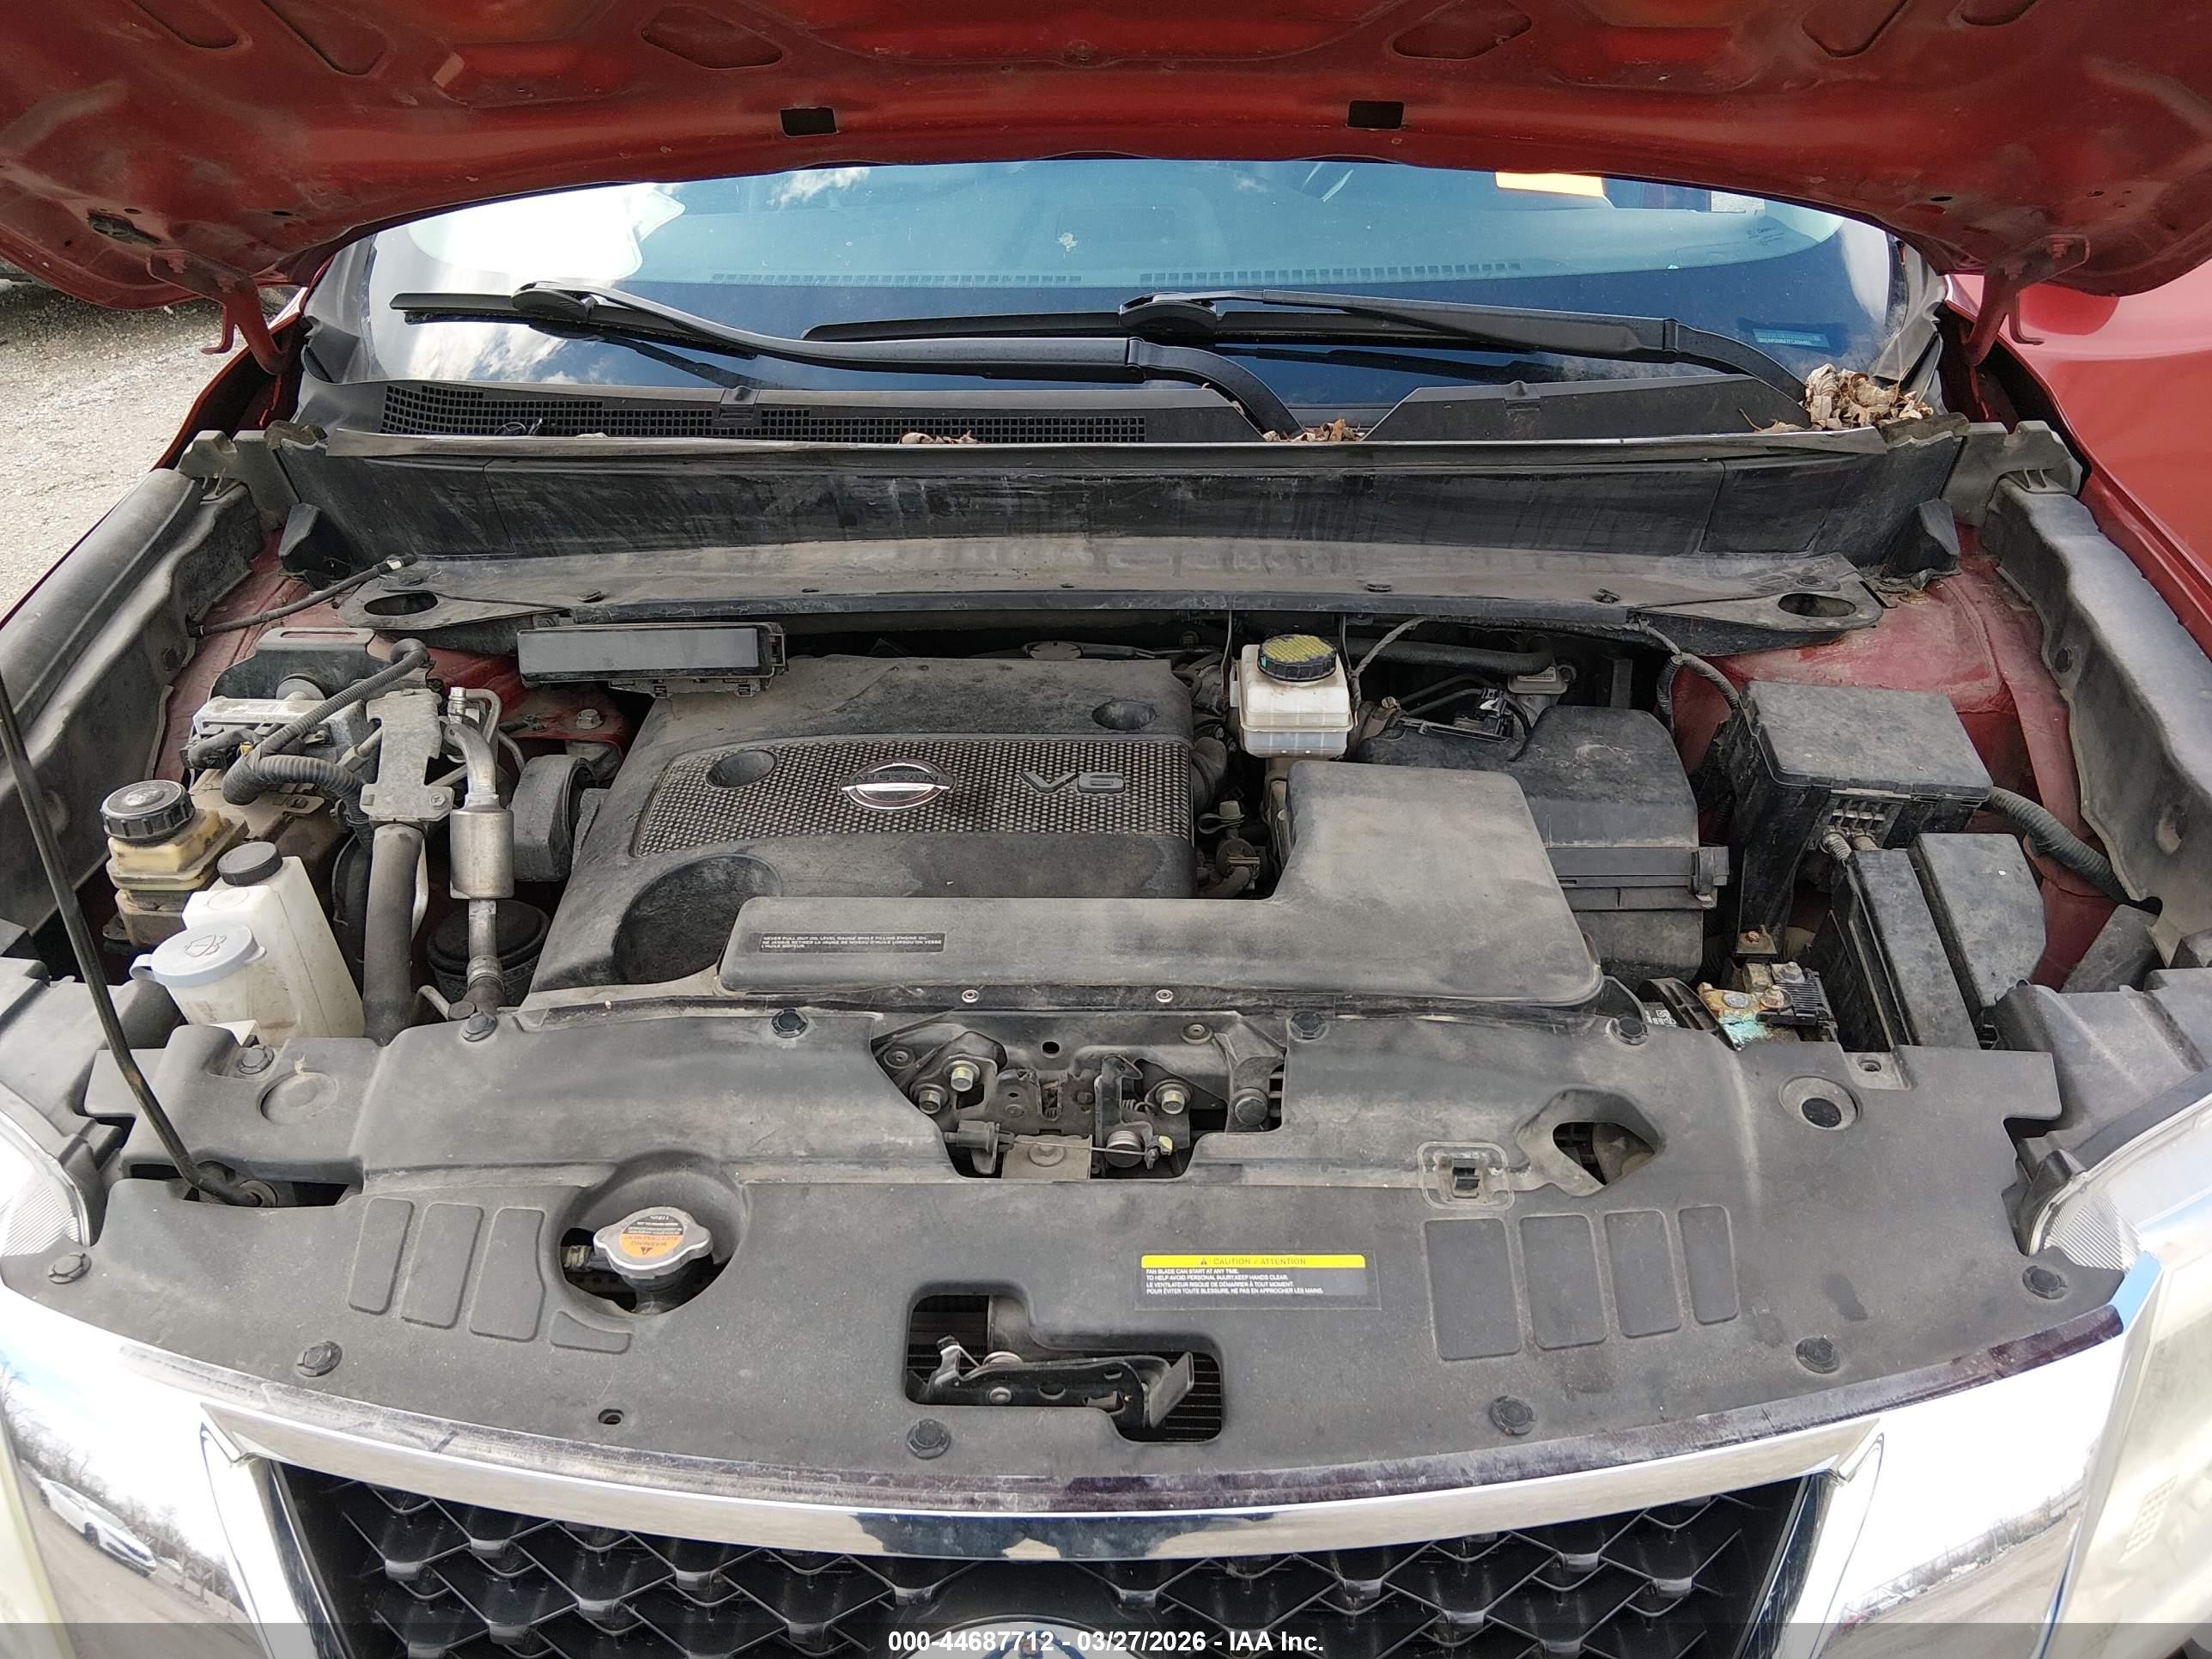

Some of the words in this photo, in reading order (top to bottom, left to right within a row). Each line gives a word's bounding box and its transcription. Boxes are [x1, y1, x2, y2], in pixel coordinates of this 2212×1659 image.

[854, 772, 939, 782] NISSAN
[1020, 772, 1125, 793] V6
[1260, 1256, 1306, 1265] ATTENTION
